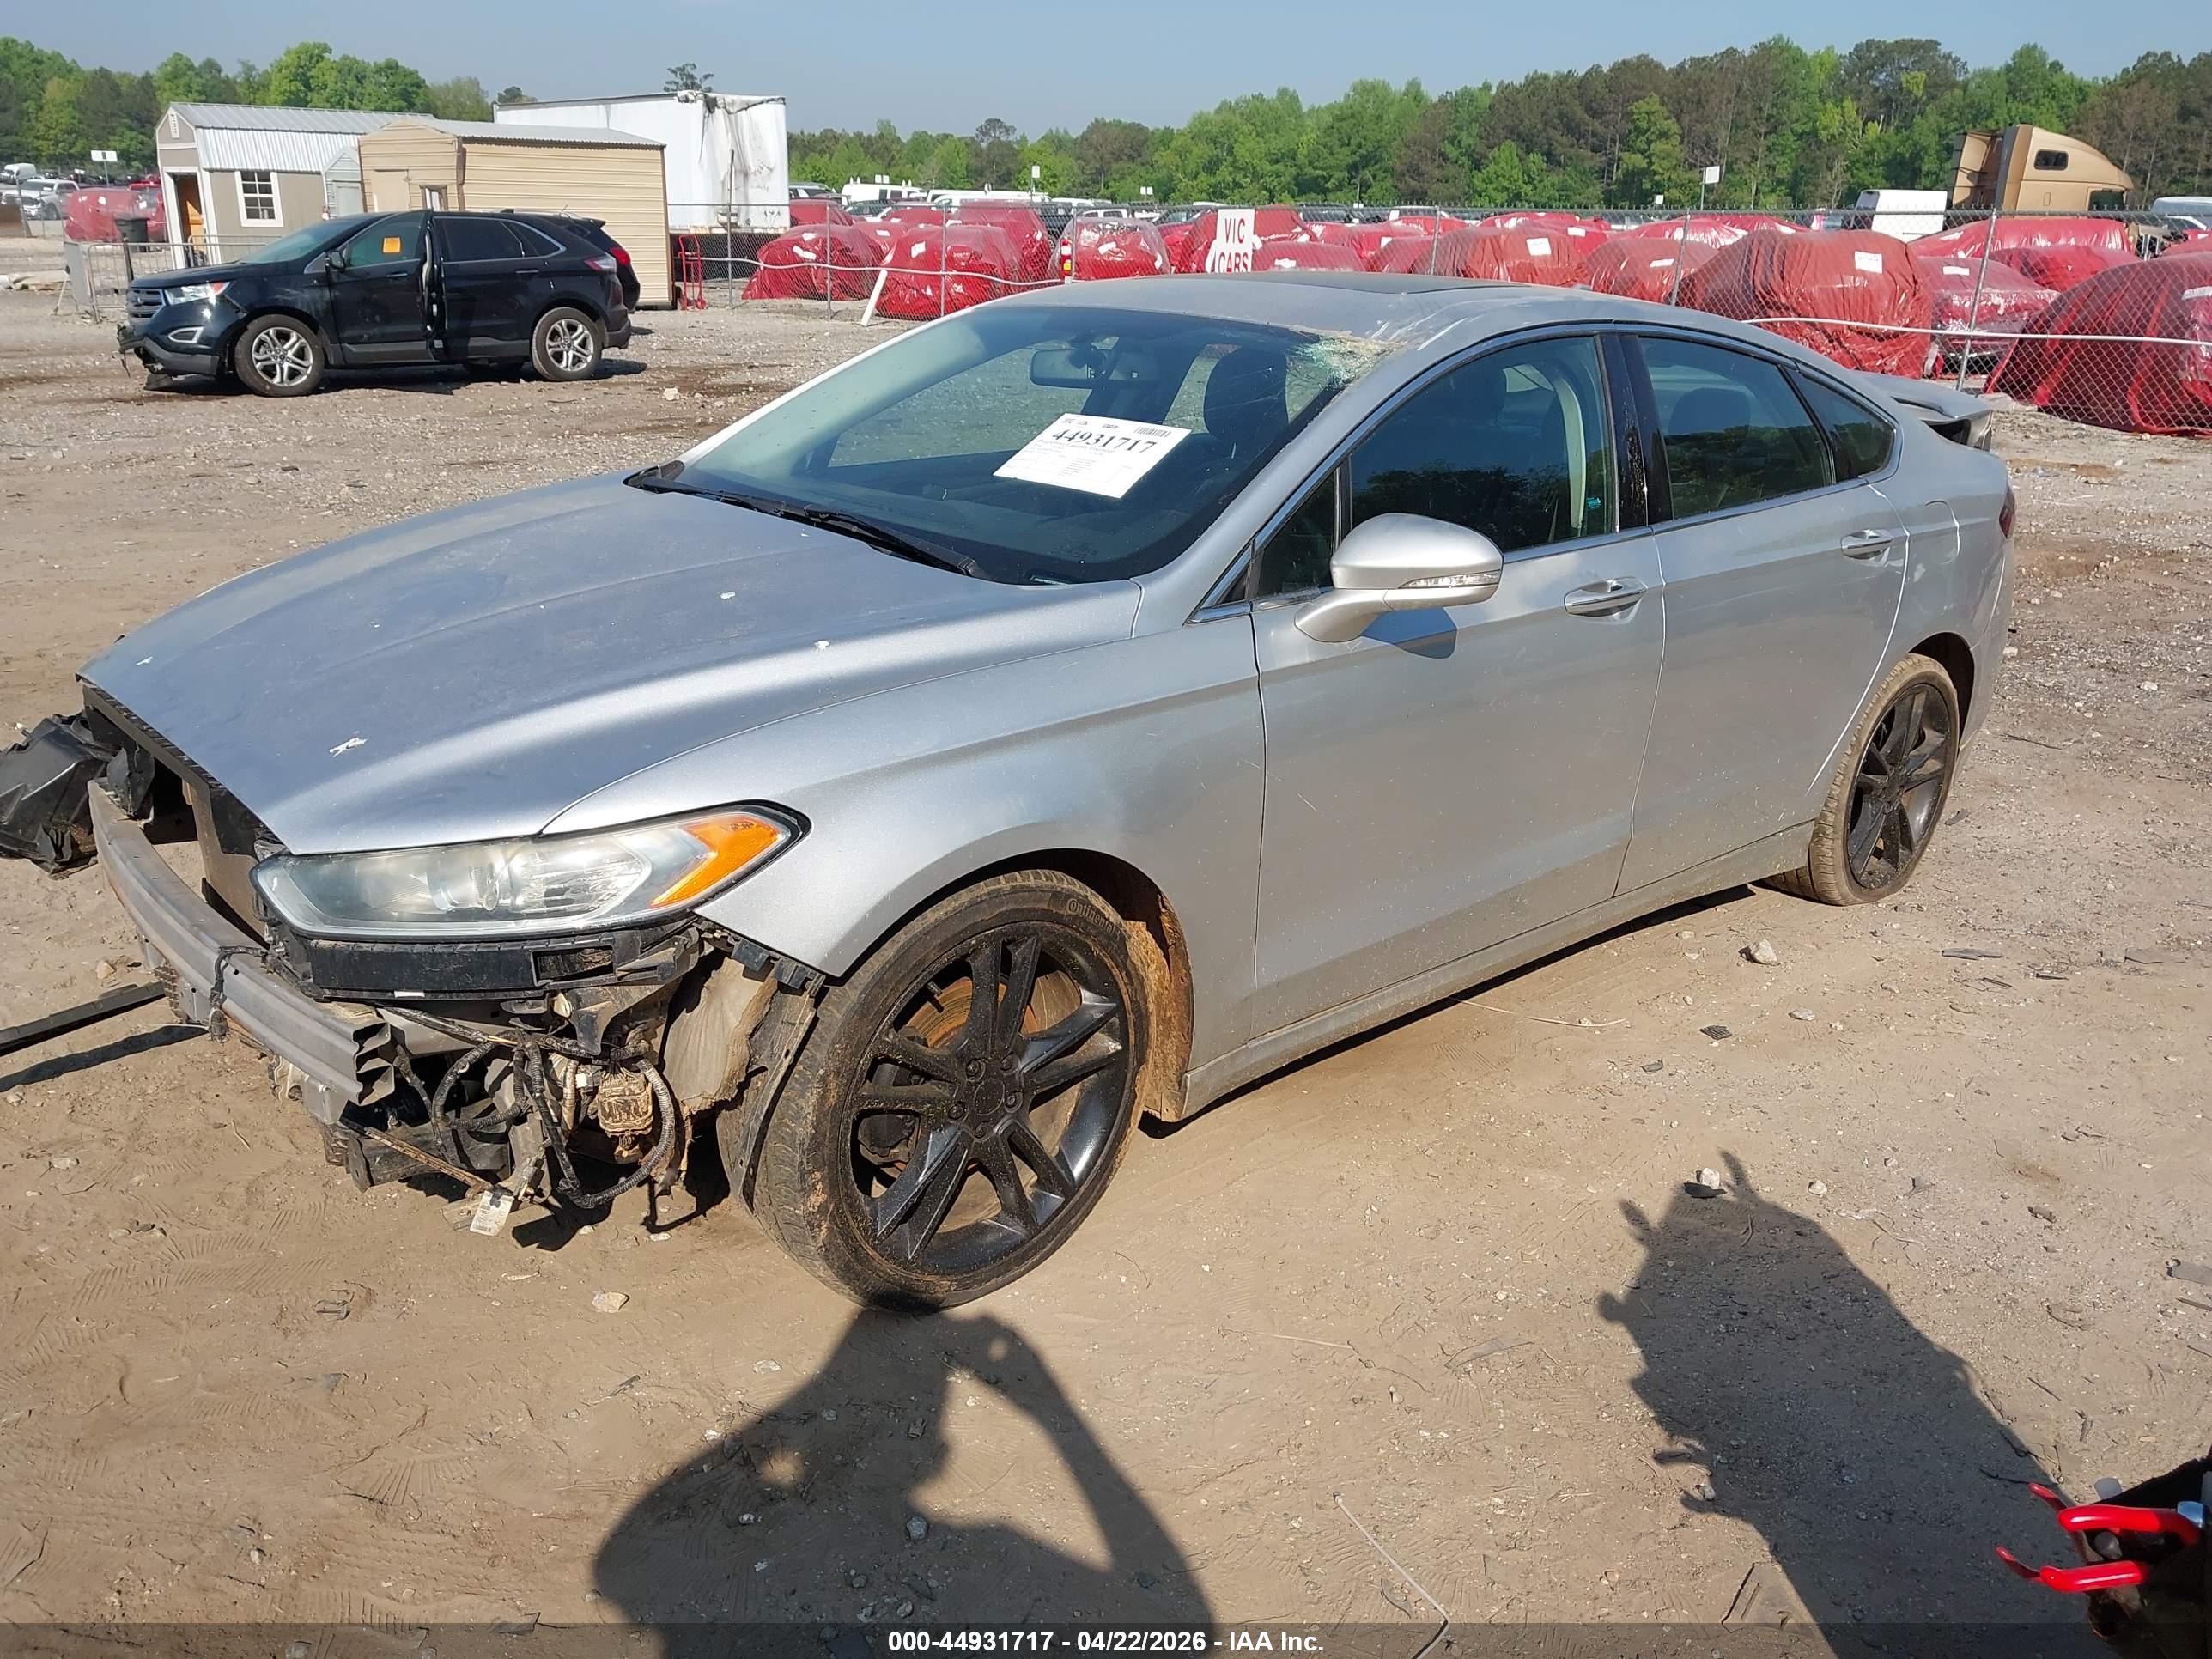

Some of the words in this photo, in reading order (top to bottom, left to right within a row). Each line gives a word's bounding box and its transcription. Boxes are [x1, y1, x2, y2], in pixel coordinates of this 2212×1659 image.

[1224, 217, 1246, 244] VIC
[1218, 252, 1249, 272] CARS
[1052, 428, 1158, 453] 44931717
